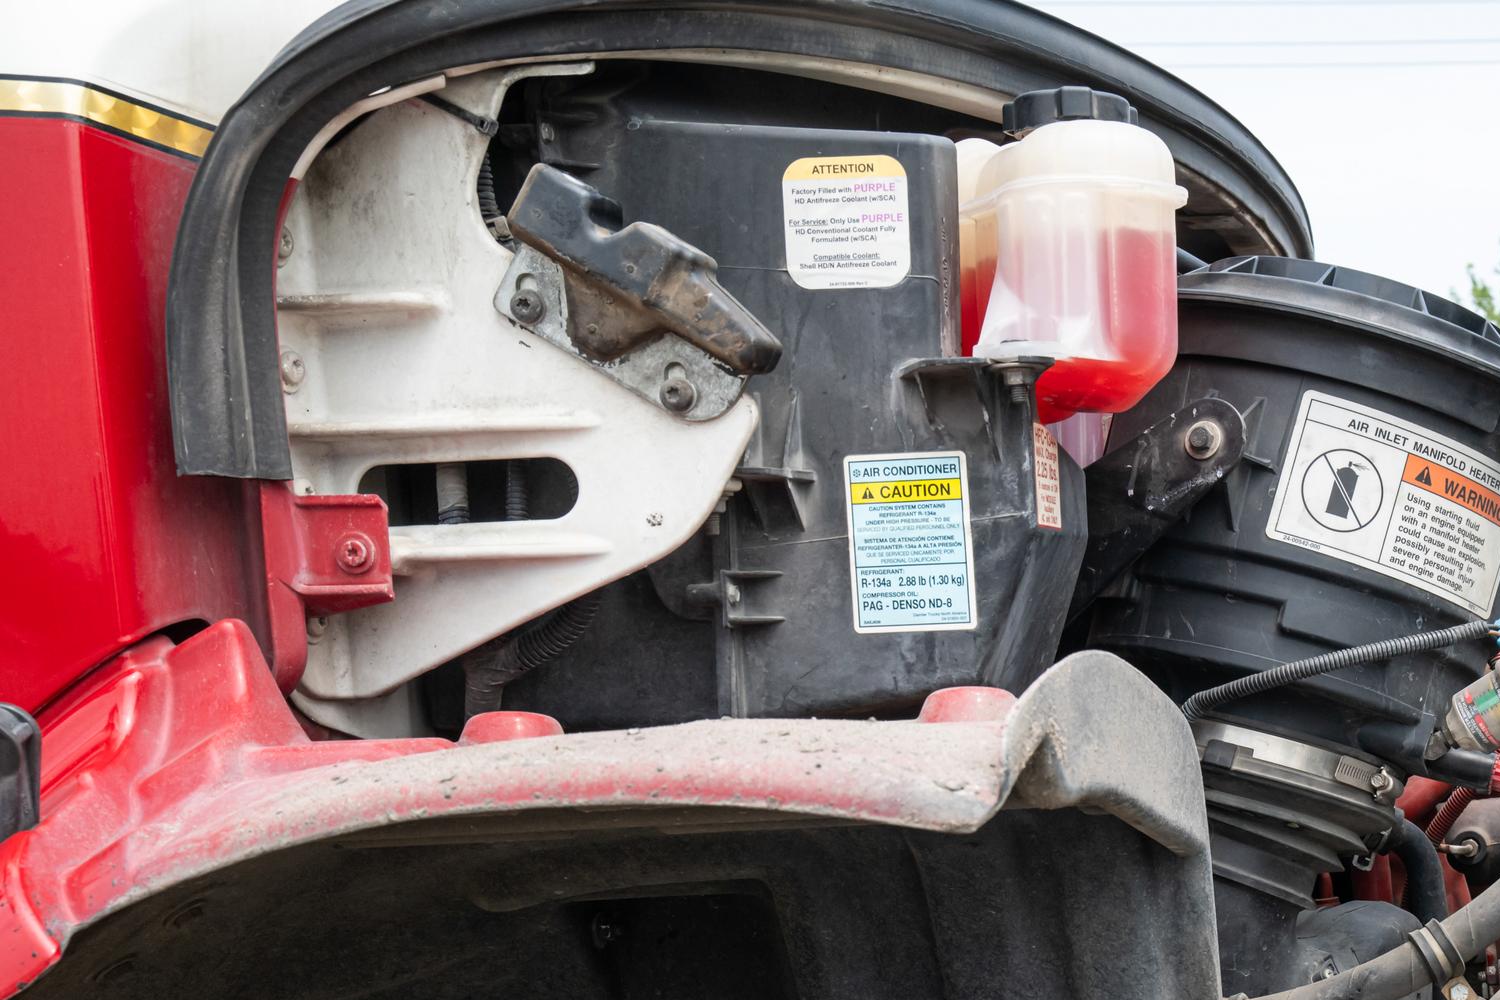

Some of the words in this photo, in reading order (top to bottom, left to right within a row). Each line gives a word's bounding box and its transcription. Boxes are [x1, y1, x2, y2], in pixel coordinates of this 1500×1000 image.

[812, 164, 874, 175] ATTENTION
[792, 188, 817, 196] Factory
[854, 182, 896, 193] PURPLE
[789, 219, 800, 227] For
[830, 218, 845, 226] Only
[862, 213, 903, 223] PURPLE
[880, 225, 896, 233] Fully
[1348, 419, 1368, 433] AIR
[1375, 427, 1409, 447] INLET
[1413, 442, 1465, 471] MANIFOLD
[1470, 466, 1500, 490] HEATER
[863, 467, 881, 478] AIR
[883, 464, 957, 477] CONDITIONER
[880, 483, 951, 499] CAUTION
[1407, 493, 1431, 511] Using
[1435, 505, 1462, 523] starting
[1465, 518, 1480, 532] fluid
[1401, 515, 1419, 528] with
[1429, 525, 1459, 545] manifold
[1462, 539, 1480, 555] heater
[1404, 506, 1415, 515] on
[1418, 510, 1428, 519] an
[1432, 514, 1455, 533] engine
[1458, 525, 1485, 546] equipped
[1398, 525, 1421, 540] could
[1423, 534, 1445, 548] cause
[1448, 543, 1457, 553] an
[1395, 536, 1431, 557] possibly
[1434, 549, 1464, 571] resulting
[1466, 564, 1473, 573] in
[1389, 555, 1406, 568] and
[1409, 561, 1434, 580] engine
[1437, 573, 1464, 593] damage.
[1392, 546, 1421, 561] severe
[1423, 555, 1455, 577] personal
[1458, 571, 1475, 588] injury
[862, 578, 891, 588] R-134a
[899, 577, 916, 586] 2.88
[919, 576, 925, 585] lb
[929, 575, 949, 587] (1.30
[952, 574, 965, 587] kg)
[863, 601, 883, 611] PAG
[892, 599, 926, 610] DENSO
[928, 599, 952, 609] ND-8
